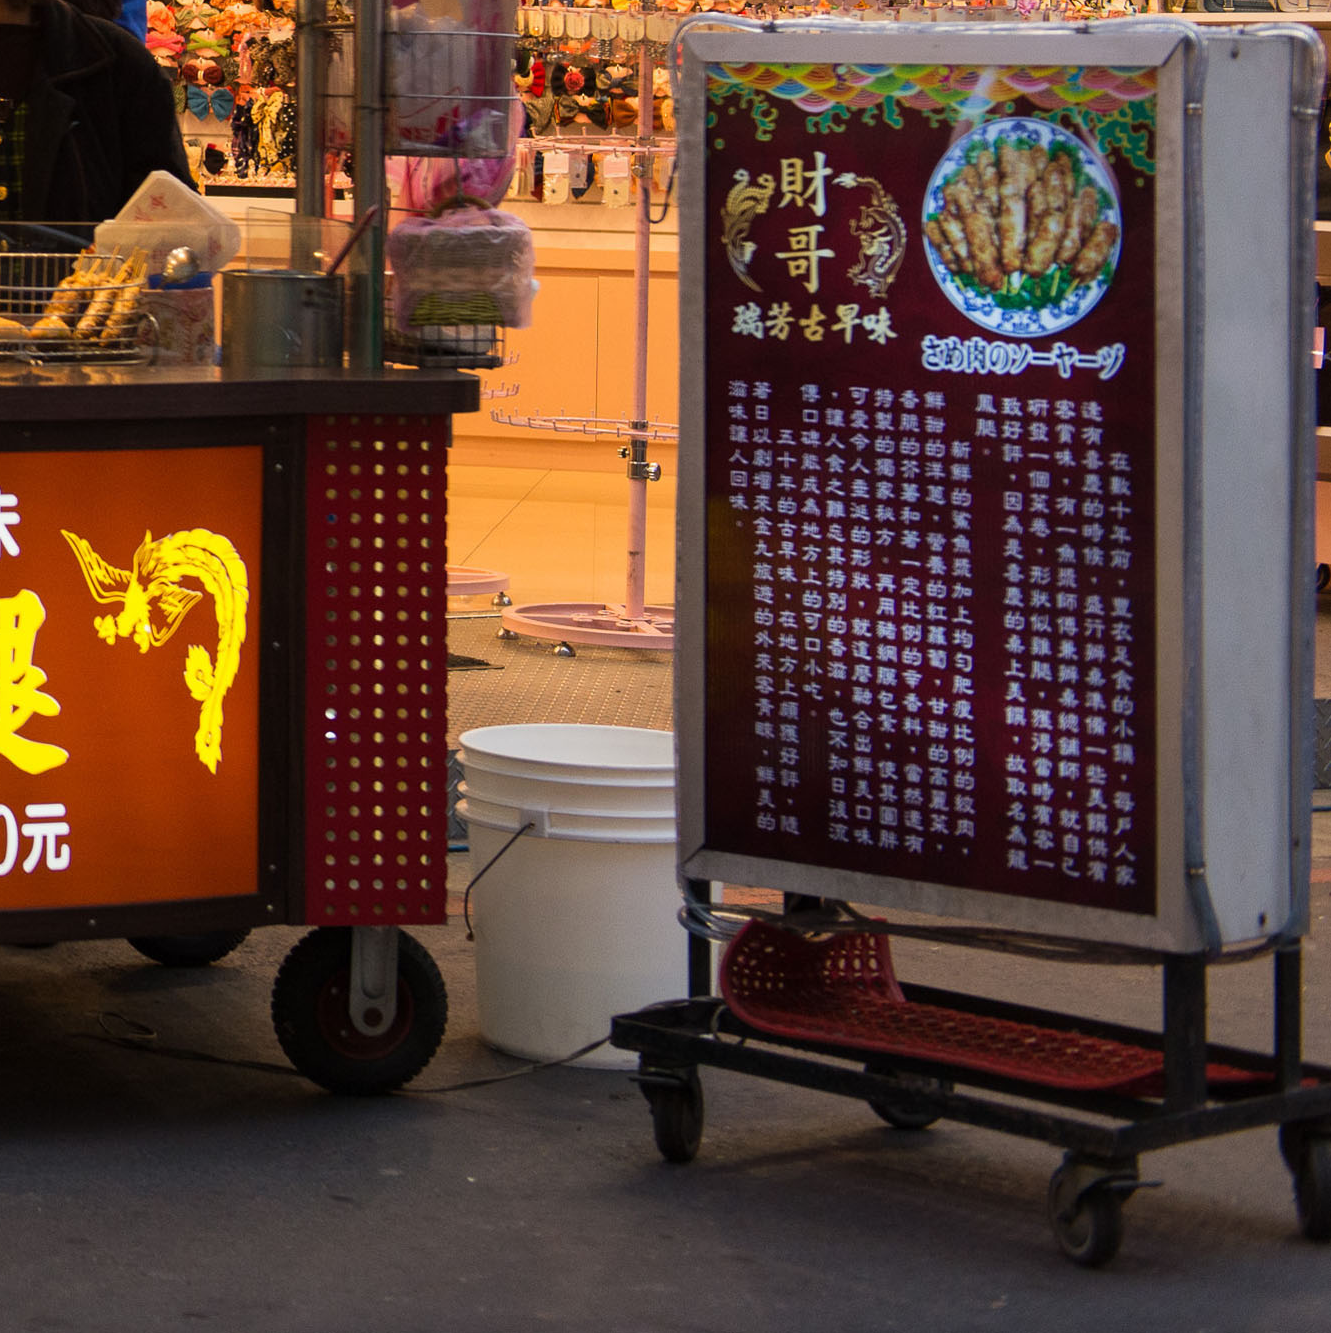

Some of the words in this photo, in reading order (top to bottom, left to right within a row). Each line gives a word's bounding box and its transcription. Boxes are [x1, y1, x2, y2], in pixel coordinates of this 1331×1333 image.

[775, 151, 835, 295] 財哥
[732, 302, 898, 346] 瑞芳古早味
